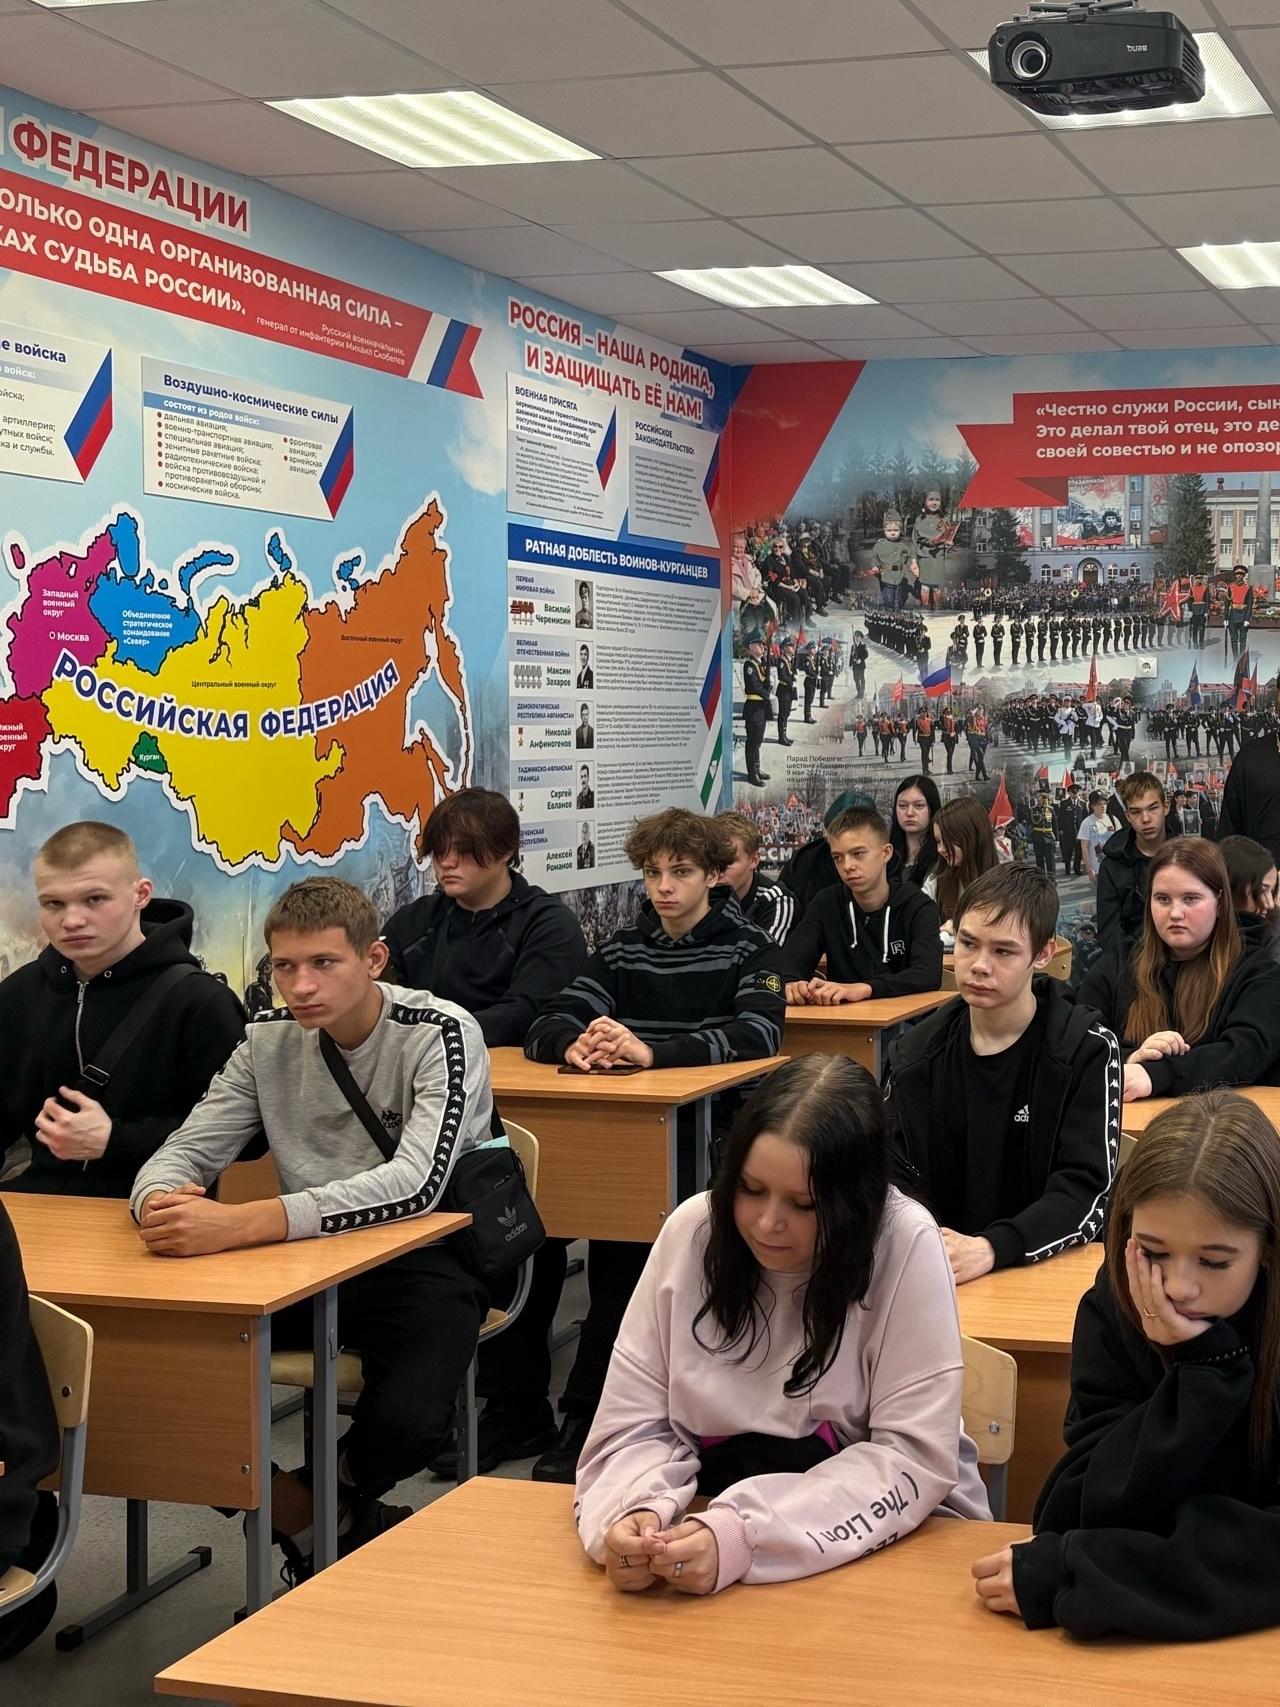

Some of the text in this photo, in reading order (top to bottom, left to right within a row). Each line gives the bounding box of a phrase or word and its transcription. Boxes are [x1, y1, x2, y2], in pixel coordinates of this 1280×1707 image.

[13, 121, 248, 232] ФЕДЕРАЦИИ
[0, 225, 246, 315] АХ СУДЬБА РОССИИ».
[88, 216, 155, 254] ОДНА
[160, 239, 341, 312] ОРГАНИЗОВАННАЯ
[345, 299, 392, 328] СИЛА
[322, 323, 351, 340] Русский
[257, 317, 405, 366] генерал от инфантерии Михаил Скобелев
[510, 301, 714, 395] РОССИЯ НАША РОДИНА,
[14, 343, 66, 363] войска
[4, 365, 36, 379] войск:
[527, 344, 703, 421] И ЗАЩИЩАТЬ ЕЁ НАМ!
[163, 374, 339, 424] Воздушно-космические силы
[515, 386, 578, 411] ВОЕННАЯ ПРИСЯГА
[164, 400, 196, 412] состоят
[197, 406, 207, 415] из
[209, 409, 233, 421] родов
[1036, 404, 1107, 416] «Честно
[1112, 402, 1168, 417] служи
[1174, 399, 1243, 413] России,
[2, 415, 56, 432] артиллерия;
[164, 413, 195, 426] дальняя
[164, 423, 242, 444] военно-транспортная
[635, 421, 673, 438] РОССИЙСКОЕ
[1036, 425, 1066, 437] Это
[1070, 425, 1123, 438] делал
[1128, 420, 1169, 434] твой
[1174, 421, 1219, 435] отец,
[1223, 420, 1253, 432] это
[164, 432, 212, 448] специальная
[165, 442, 200, 456] зенитные
[1036, 444, 1087, 458] своей
[1092, 443, 1175, 457] совестью
[1181, 443, 1192, 454] и
[1197, 443, 1218, 454] не
[525, 538, 708, 579] РАТНАЯ ДОБЛЕСТЬ ВОИНОВ-КУРГАНЦЕВ
[42, 589, 79, 599] Западный
[42, 600, 75, 608] военный
[544, 603, 571, 614] Василий
[43, 609, 64, 618] округ
[122, 610, 171, 620] Объединенное
[536, 614, 571, 626] Черемисин
[122, 620, 173, 629] стратегическое
[57, 632, 89, 642] Москва
[123, 629, 170, 637] командование
[547, 666, 571, 675] Максим
[191, 679, 277, 690] Центральный военный округ
[546, 677, 571, 687] Захаров
[55, 654, 398, 738] РОССИЙСКАЯ ФЕДЕРАЦИЯ
[545, 727, 571, 737] Николай
[530, 739, 572, 750] Анфиногенов
[139, 753, 160, 762] Курган
[550, 789, 572, 799] Сергей
[547, 801, 572, 810] Евланов
[547, 849, 572, 860] Алексей
[546, 862, 572, 872] Романов
